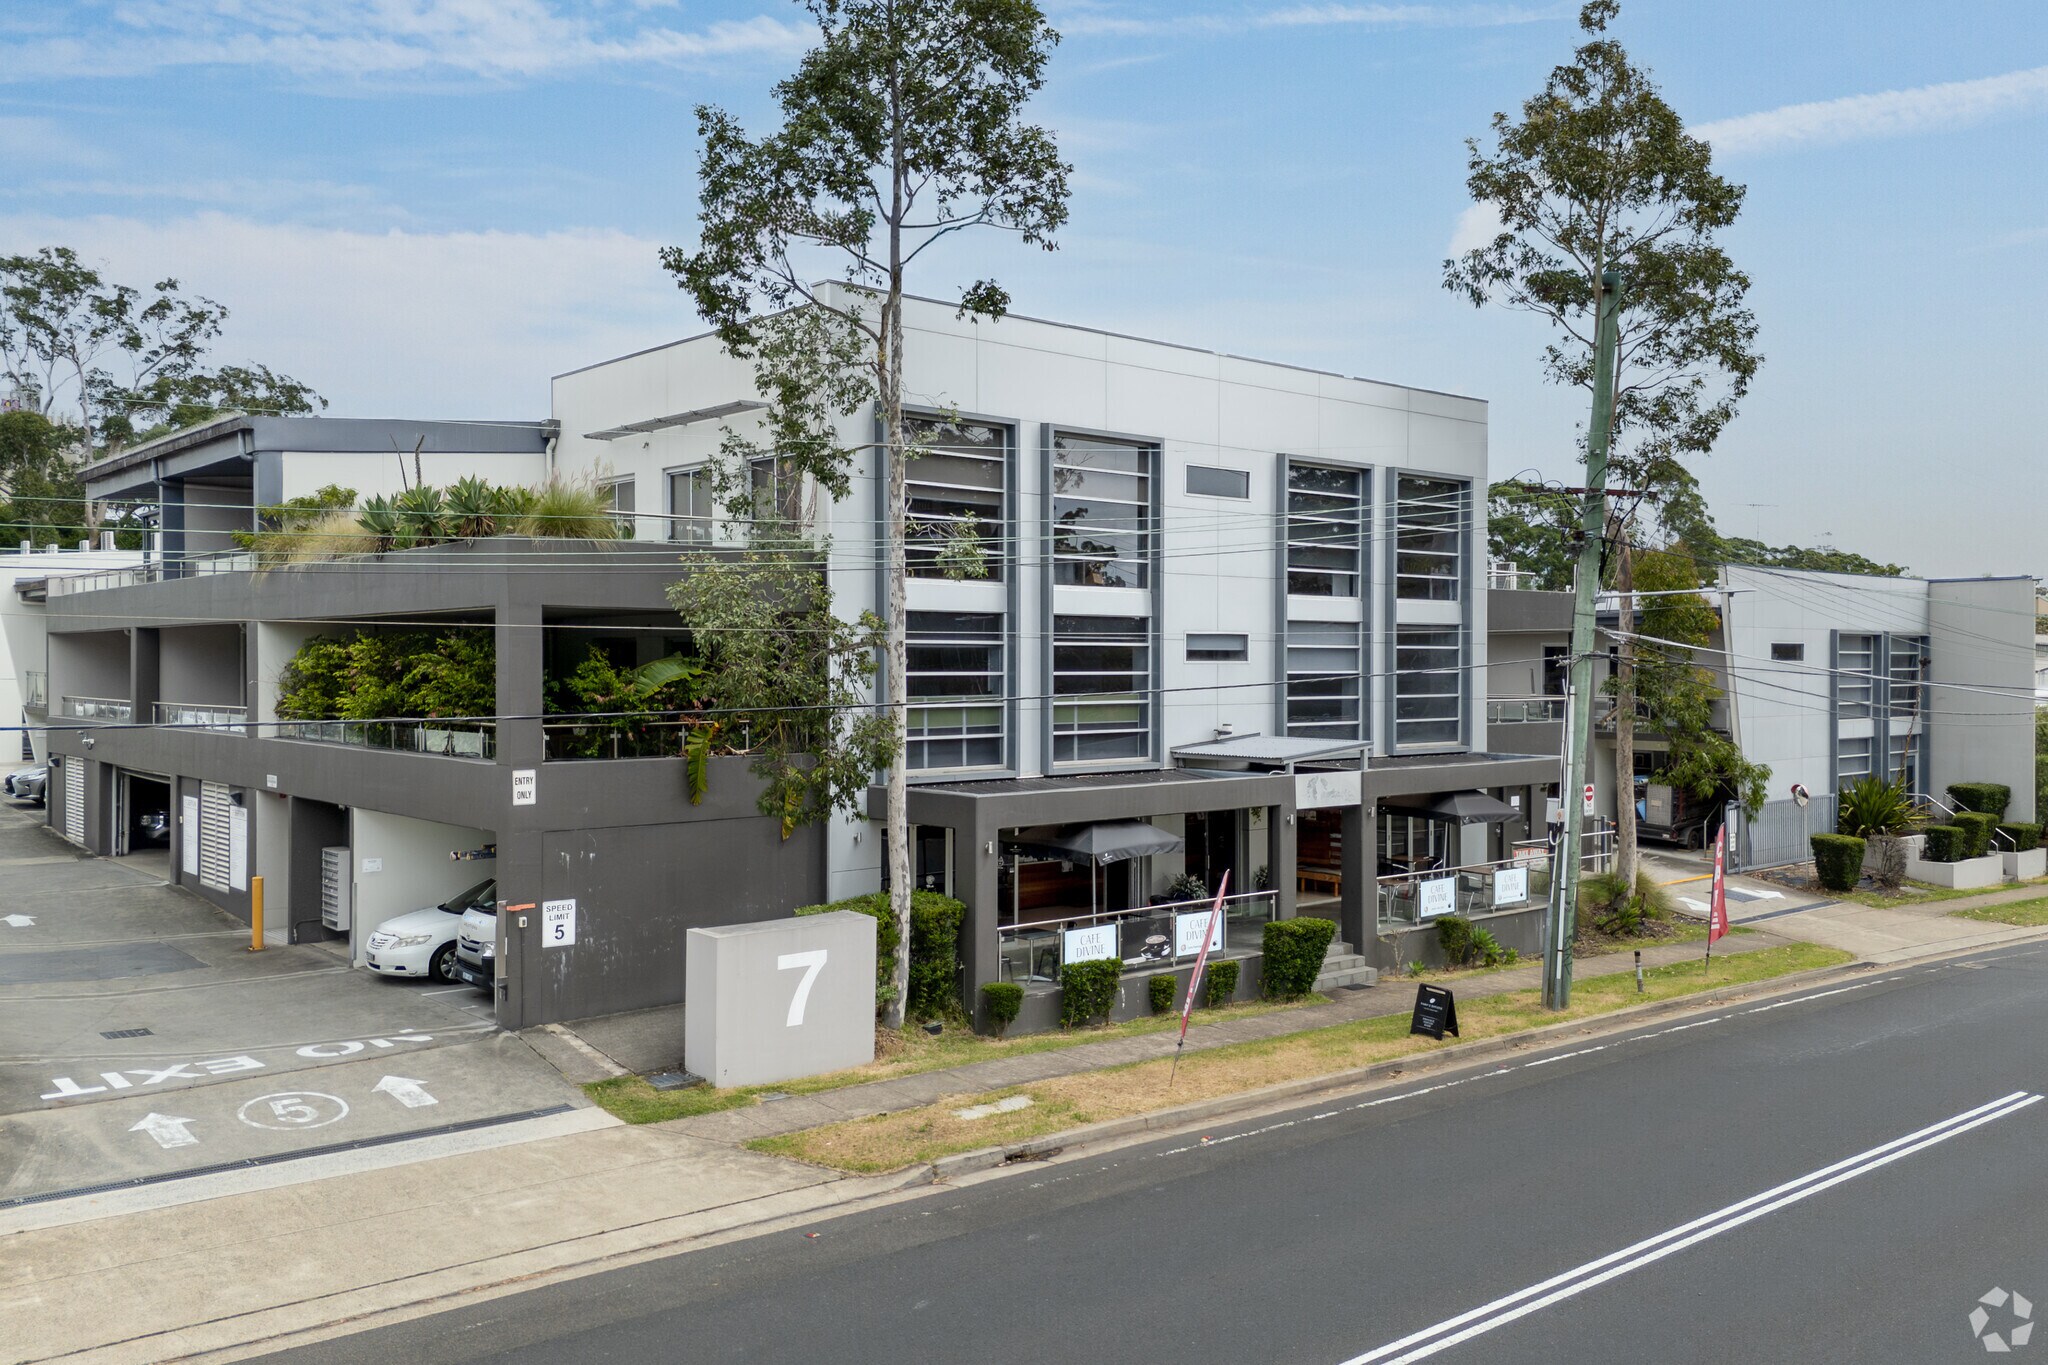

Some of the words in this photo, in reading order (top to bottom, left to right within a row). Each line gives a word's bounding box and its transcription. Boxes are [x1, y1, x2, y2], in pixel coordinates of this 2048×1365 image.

[514, 776, 534, 786] ENTRY
[516, 790, 532, 800] ONLY
[1430, 884, 1445, 894] CAFE
[545, 904, 573, 913] SPEED
[548, 913, 570, 921] LIMIT
[1190, 918, 1208, 930] CAFE
[554, 924, 565, 940] 5
[1186, 929, 1207, 941] DIVIN
[1080, 933, 1102, 946] CAFE
[1076, 944, 1104, 958] DIVINE
[777, 949, 828, 1028] 7
[40, 1056, 266, 1100] EXIT
[268, 1097, 320, 1123] 5
